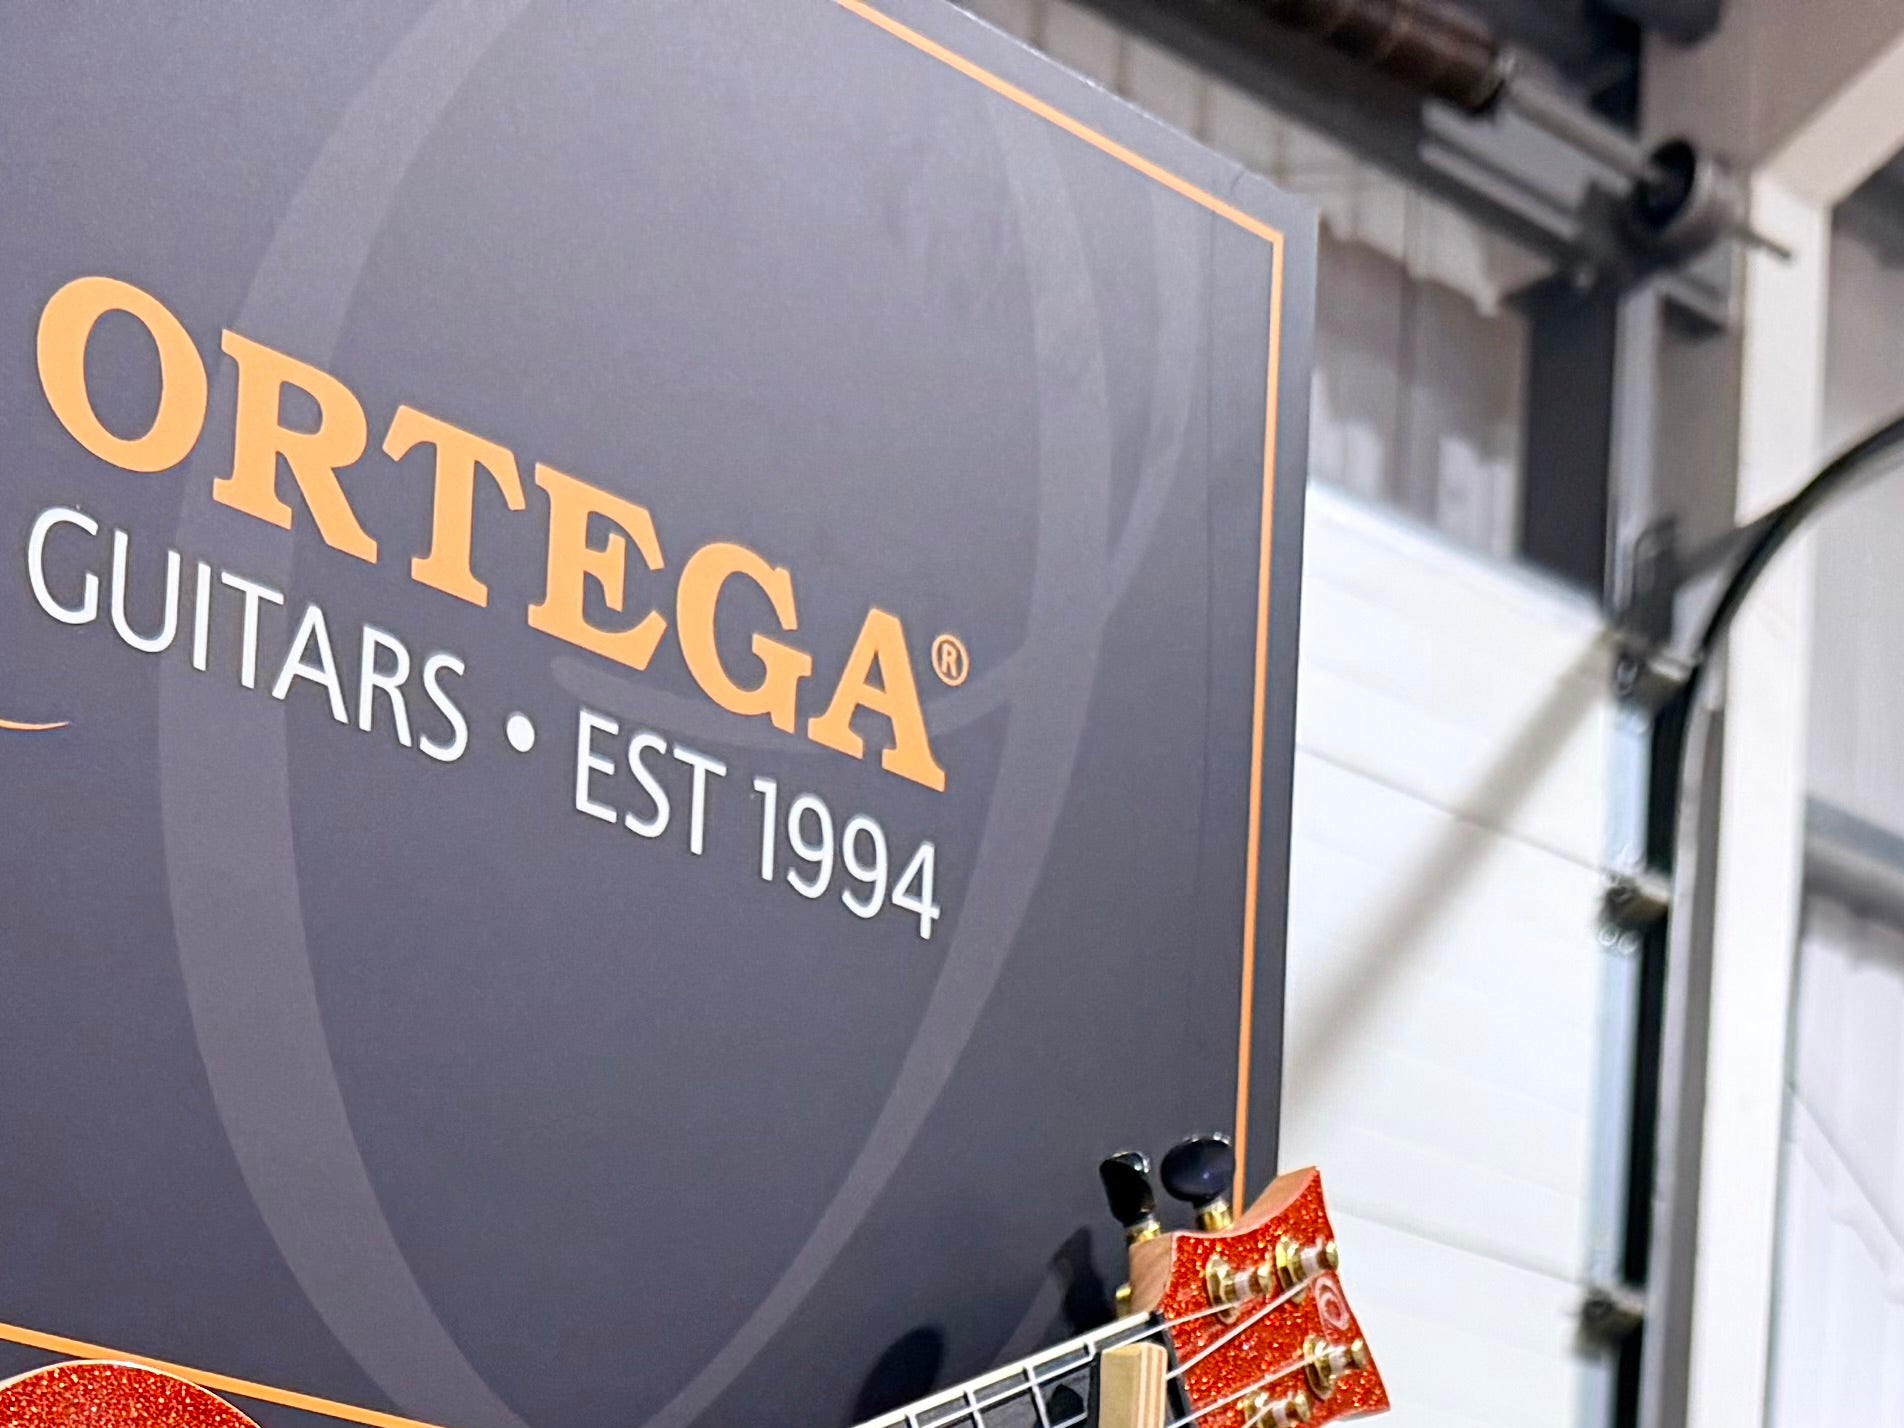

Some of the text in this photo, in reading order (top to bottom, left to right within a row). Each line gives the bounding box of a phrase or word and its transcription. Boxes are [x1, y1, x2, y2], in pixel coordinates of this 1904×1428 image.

[26, 506, 941, 941] GUITARS EST 1994
